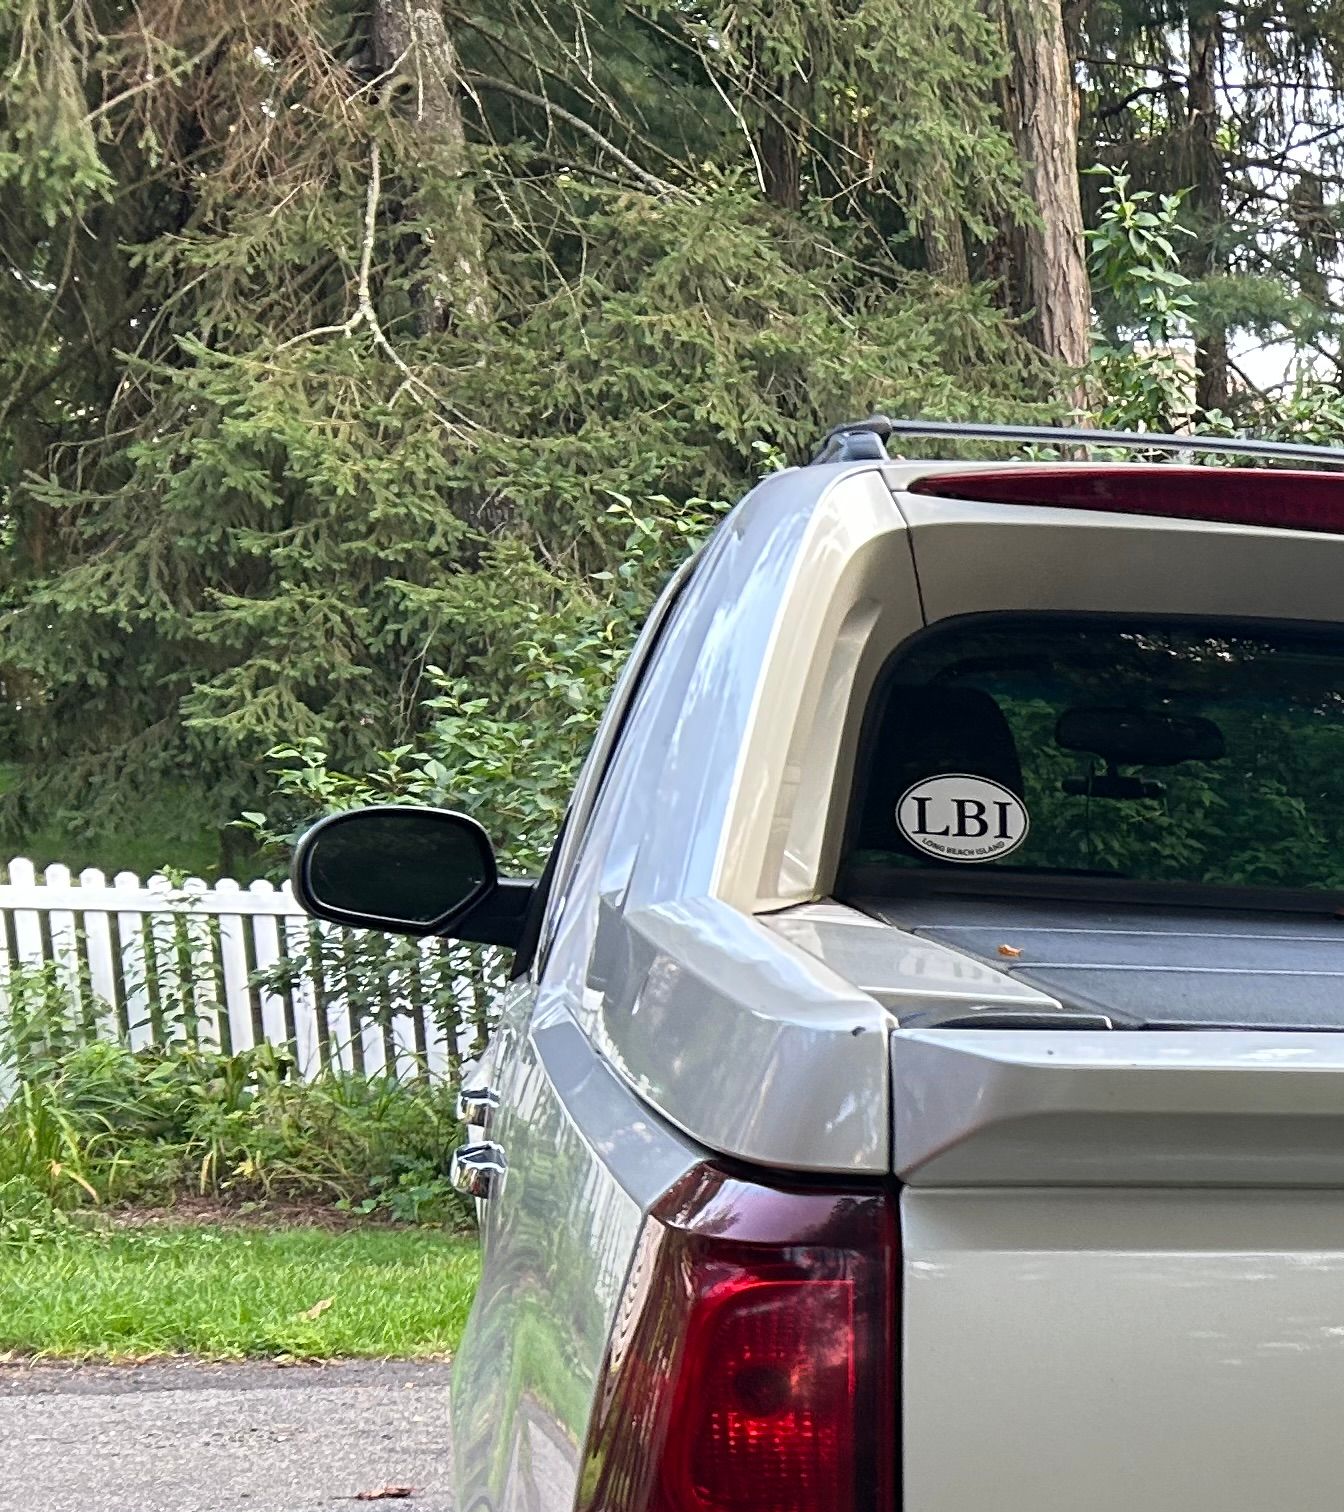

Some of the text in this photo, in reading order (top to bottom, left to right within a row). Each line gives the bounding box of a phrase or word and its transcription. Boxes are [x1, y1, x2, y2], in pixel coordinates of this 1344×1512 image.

[911, 796, 1014, 839] LBI
[921, 838, 1005, 856] LONG BEACH ISLAND
